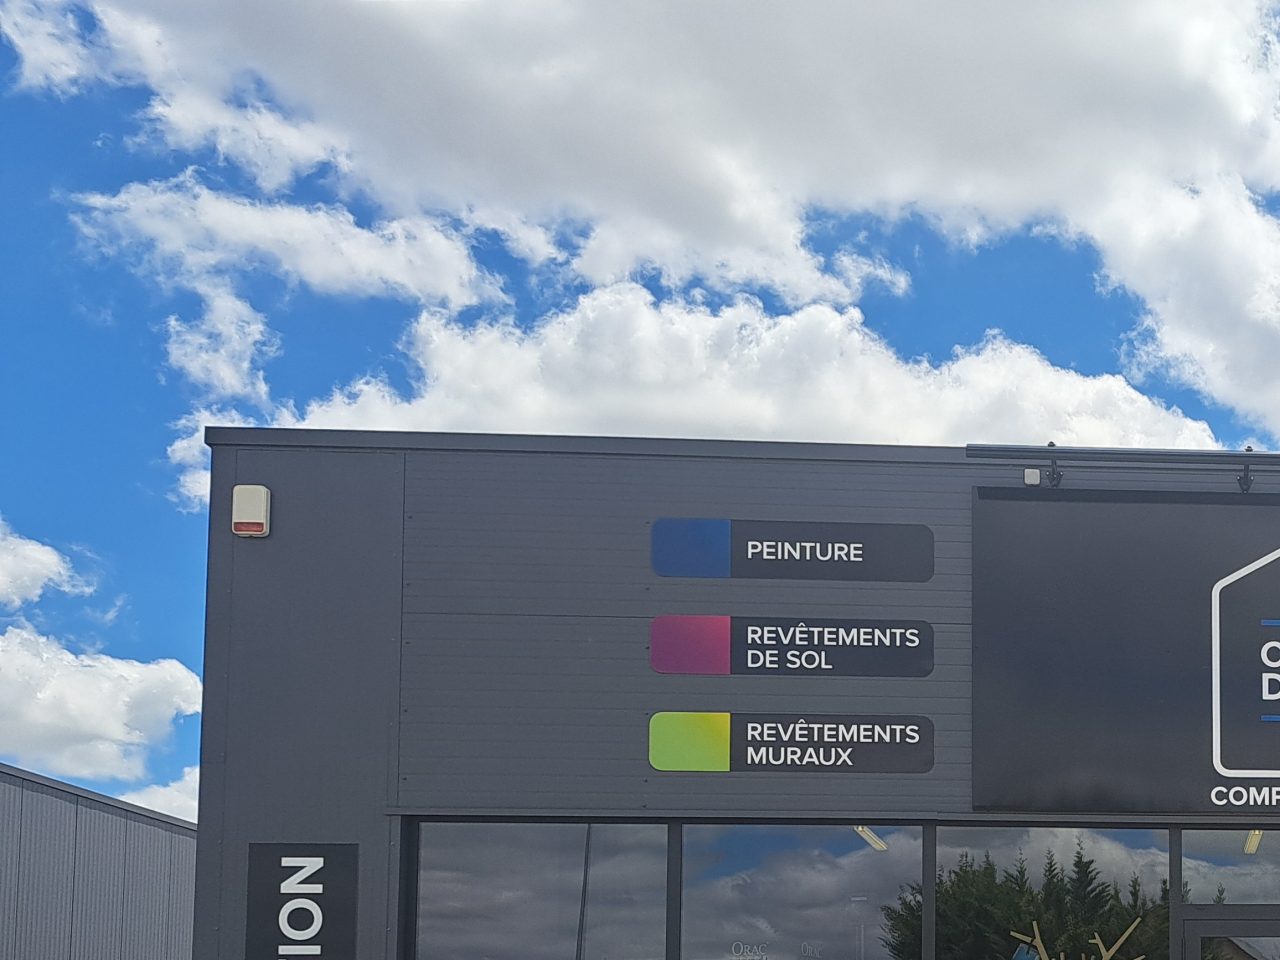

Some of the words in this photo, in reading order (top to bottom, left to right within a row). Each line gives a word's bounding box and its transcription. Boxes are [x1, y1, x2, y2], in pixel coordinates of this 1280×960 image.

[747, 541, 864, 562] PEINTURE
[747, 622, 920, 647] REVÊTEMENTS
[747, 650, 779, 669] DE
[786, 650, 833, 669] SOL
[747, 719, 920, 744] REVÊTEMENTS
[747, 747, 854, 766] MURAUX
